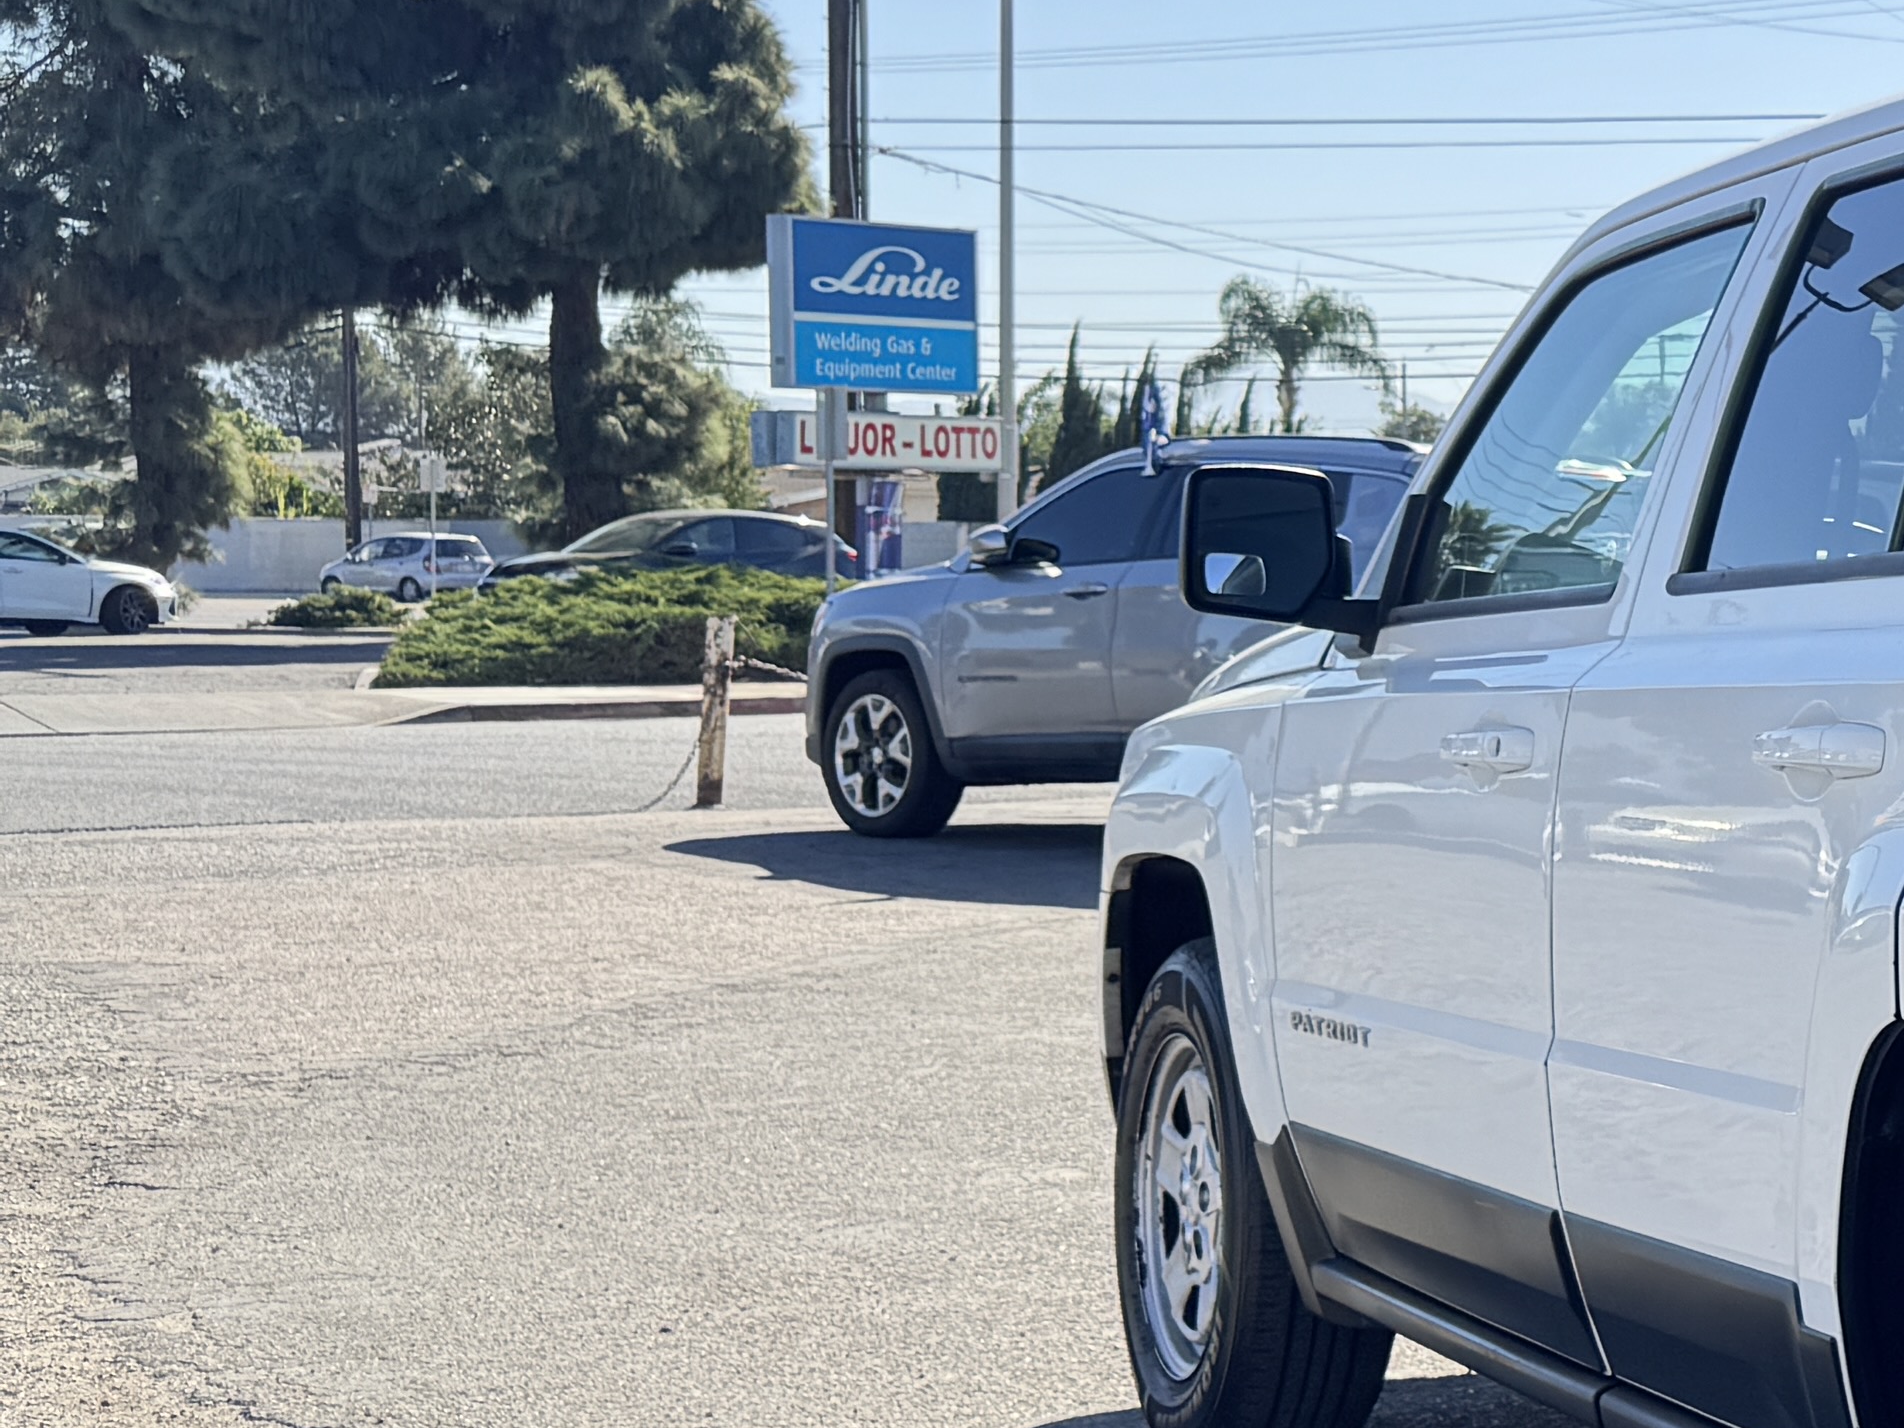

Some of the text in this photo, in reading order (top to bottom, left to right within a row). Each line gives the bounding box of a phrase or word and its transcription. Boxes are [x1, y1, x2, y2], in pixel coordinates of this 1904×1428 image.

[810, 245, 960, 301] Linde
[815, 332, 932, 358] Welding Gas &
[815, 358, 957, 382] Equipment Center
[800, 420, 897, 457] LUOR
[920, 424, 997, 459] LOTTO
[1290, 1010, 1372, 1048] PATRIOT
